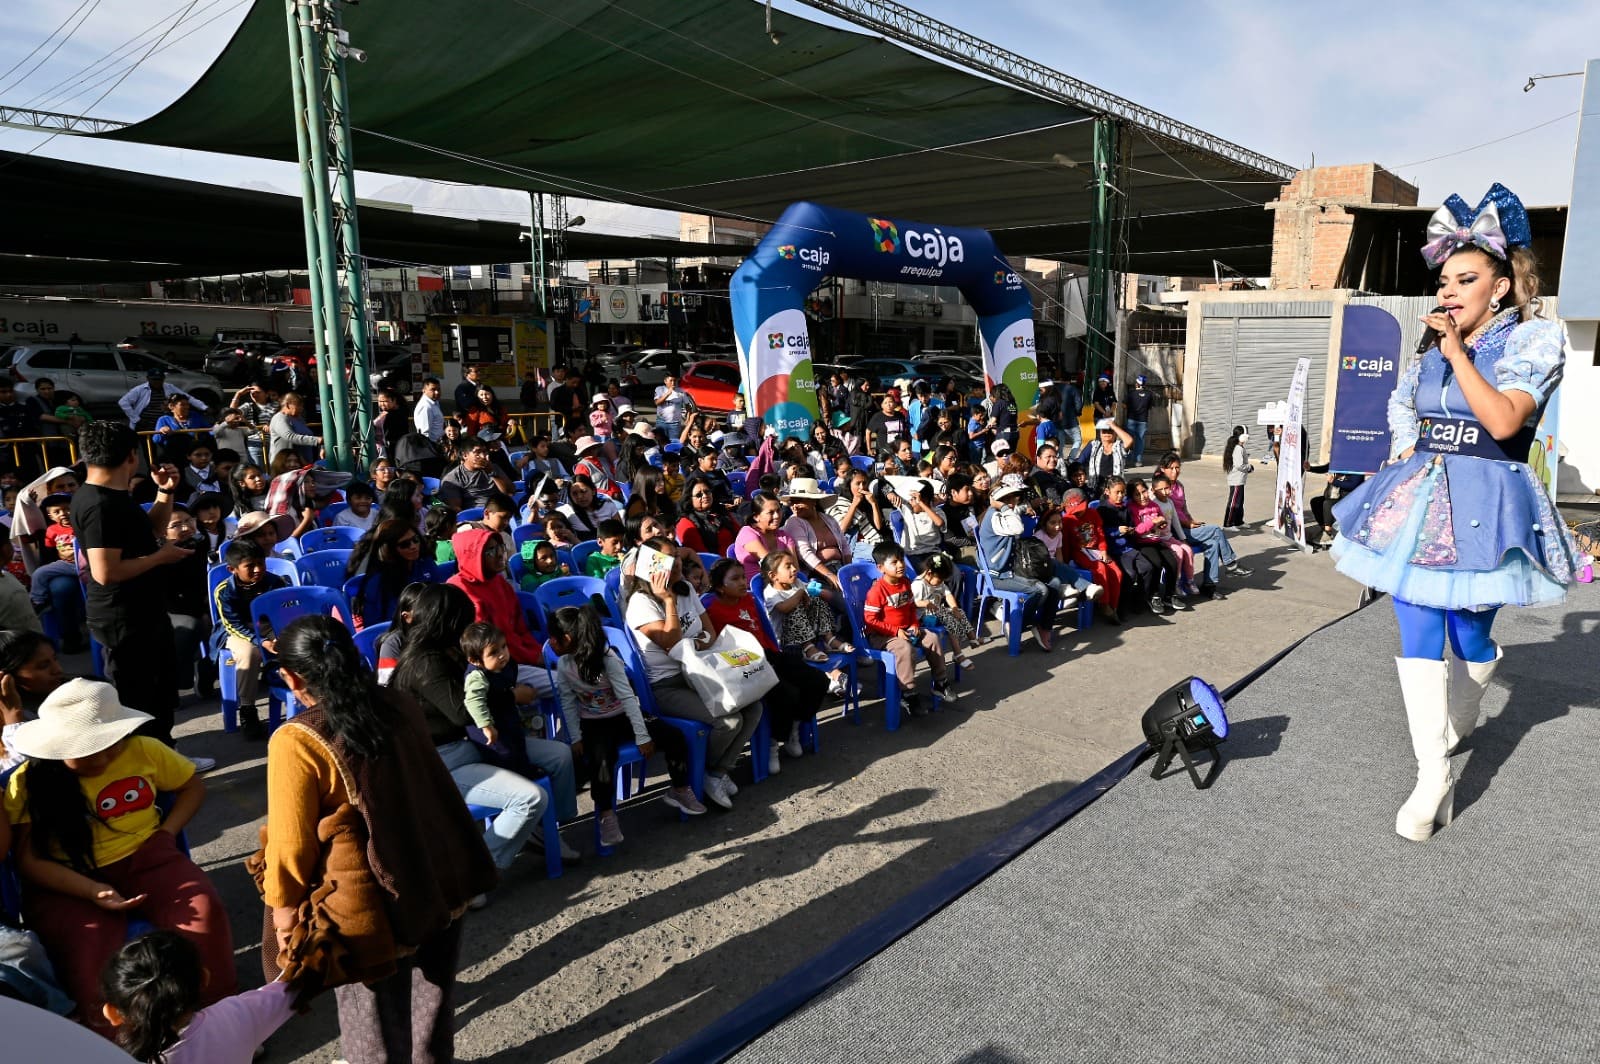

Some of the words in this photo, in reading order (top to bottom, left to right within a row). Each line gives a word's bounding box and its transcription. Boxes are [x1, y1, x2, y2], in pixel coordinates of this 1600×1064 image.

[905, 228, 964, 267] caja
[799, 247, 830, 266] caja
[901, 266, 943, 278] arequipa
[12, 320, 59, 336] caja
[161, 322, 200, 336] caja
[1358, 356, 1393, 373] caja
[788, 417, 809, 428] caja
[1431, 420, 1479, 445] caja
[1429, 443, 1460, 452] arequipa
